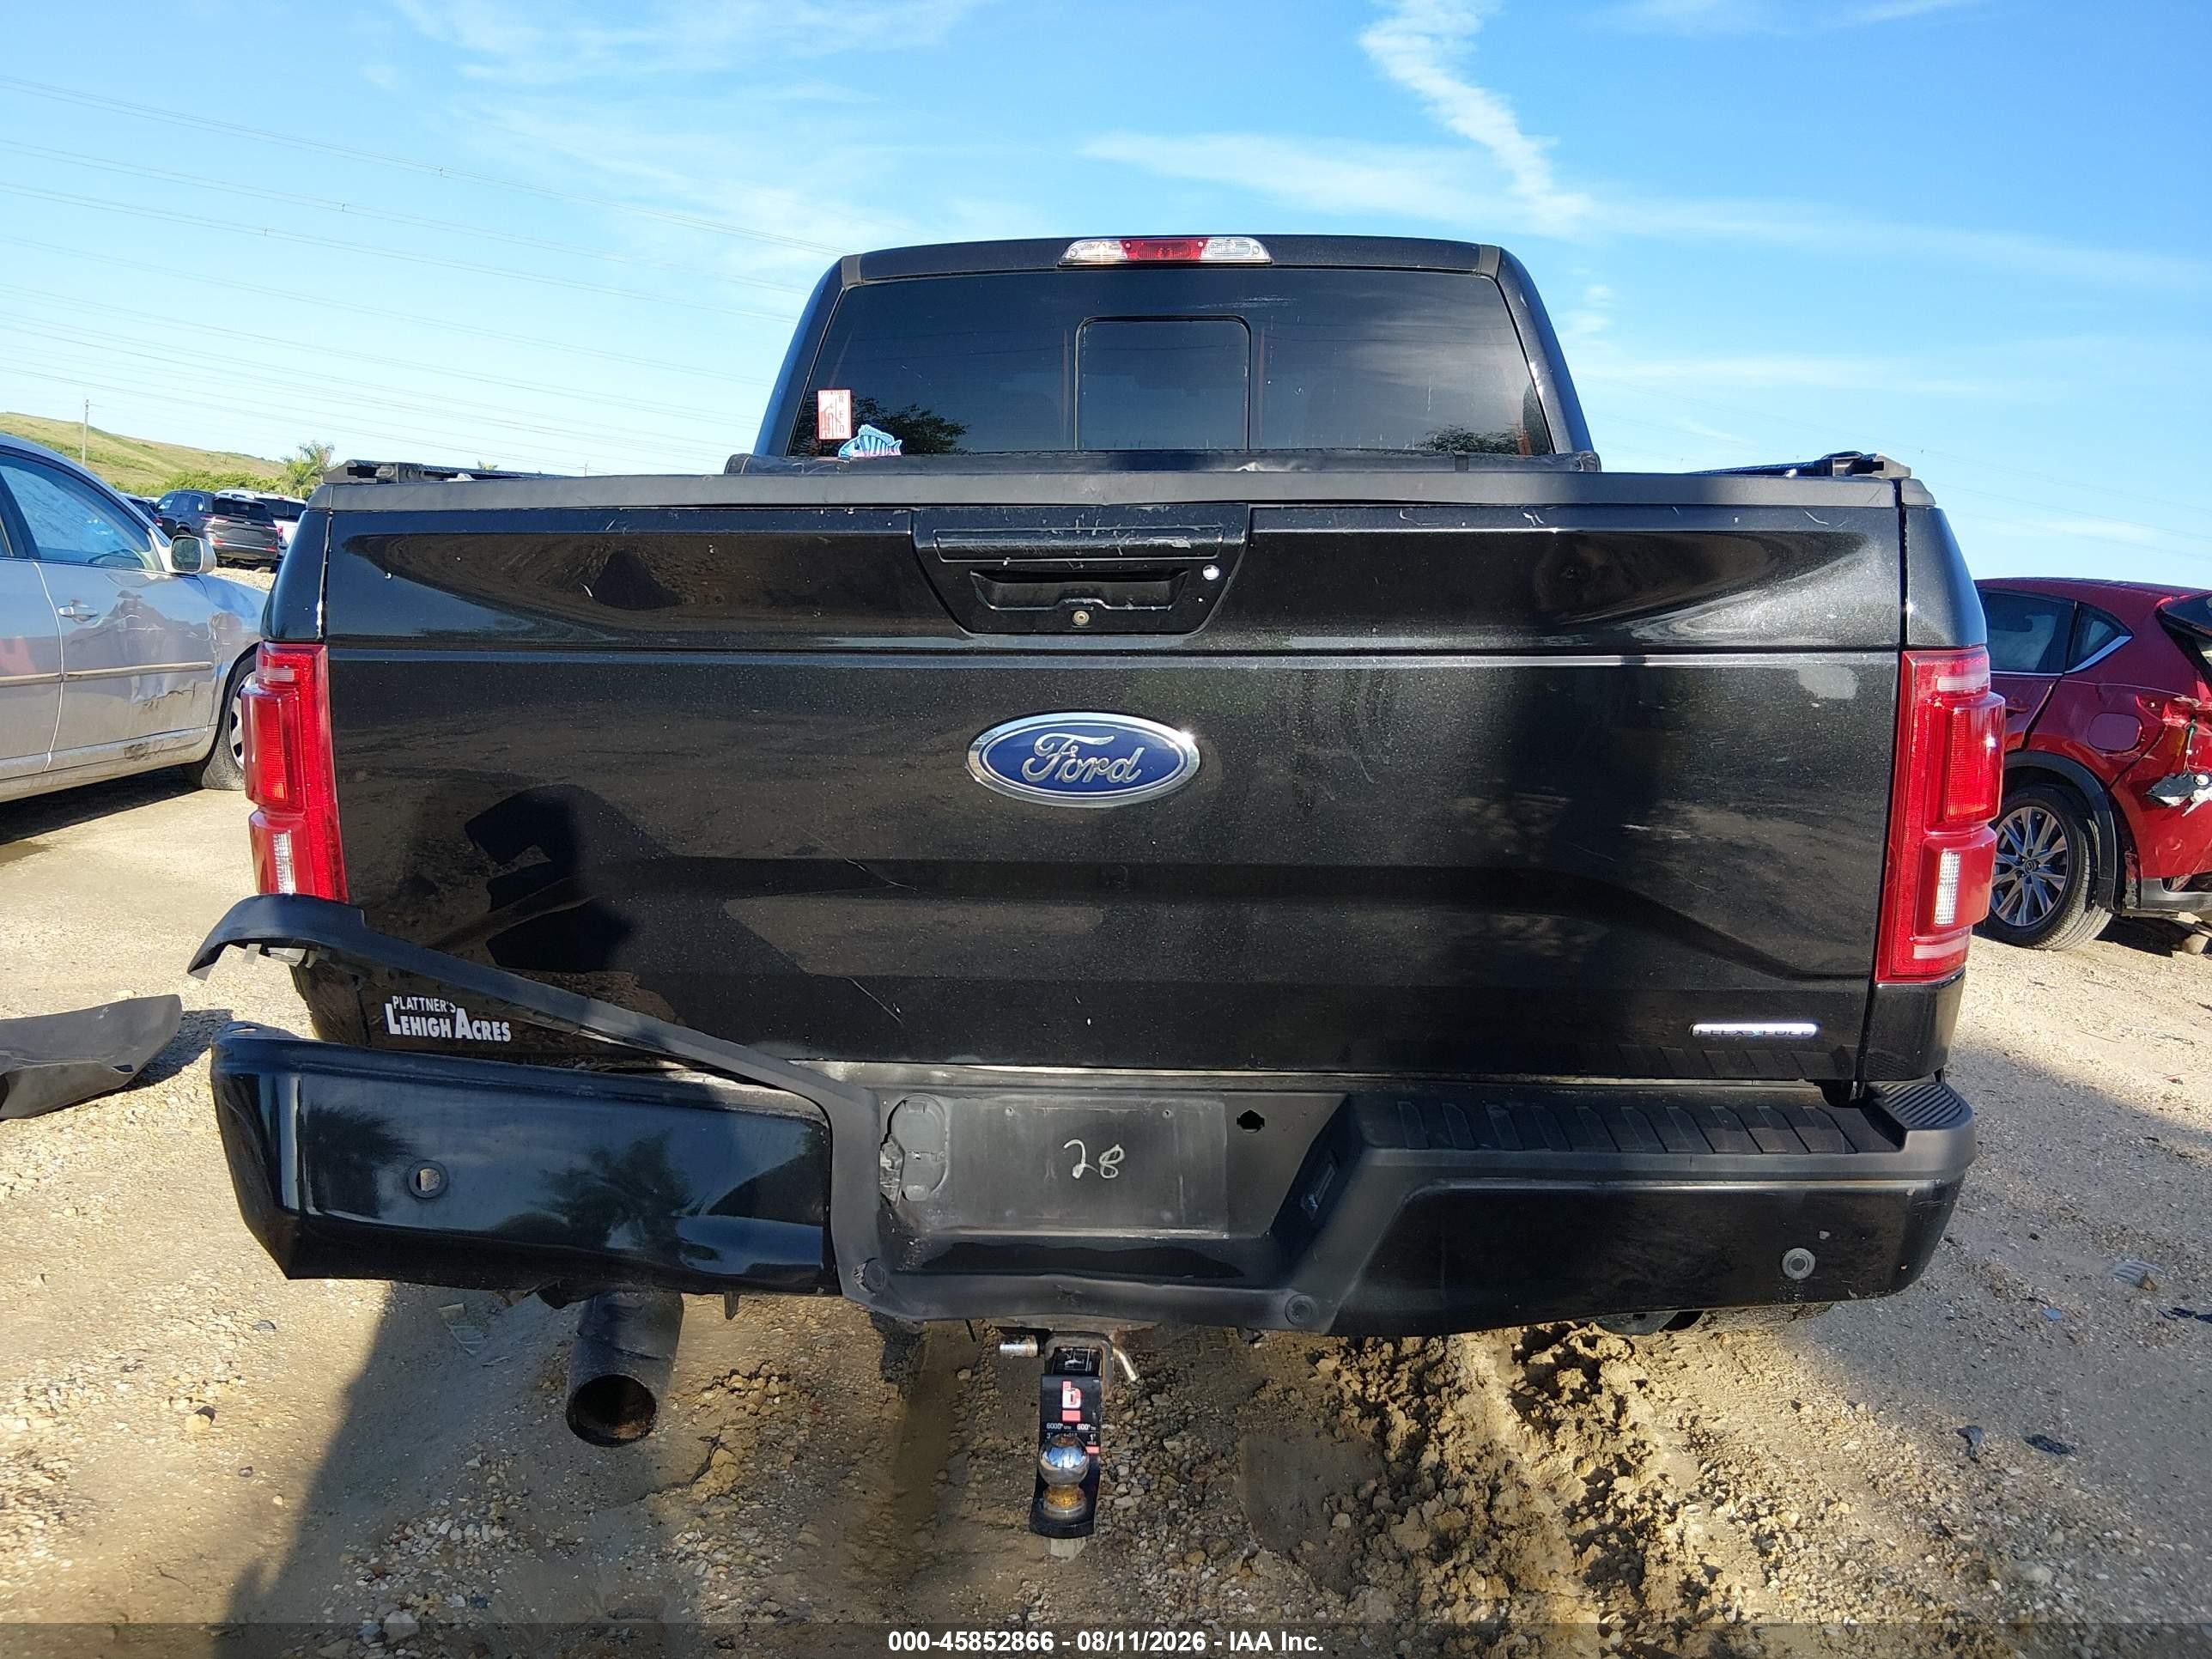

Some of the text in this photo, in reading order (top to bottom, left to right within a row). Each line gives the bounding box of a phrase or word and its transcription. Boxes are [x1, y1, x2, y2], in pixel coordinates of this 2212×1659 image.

[1022, 732, 1146, 783] Ford
[385, 1003, 512, 1042] LEHIGH ACRES
[392, 995, 457, 1013] PLATTNER'S
[1063, 1139, 1126, 1179] 28
